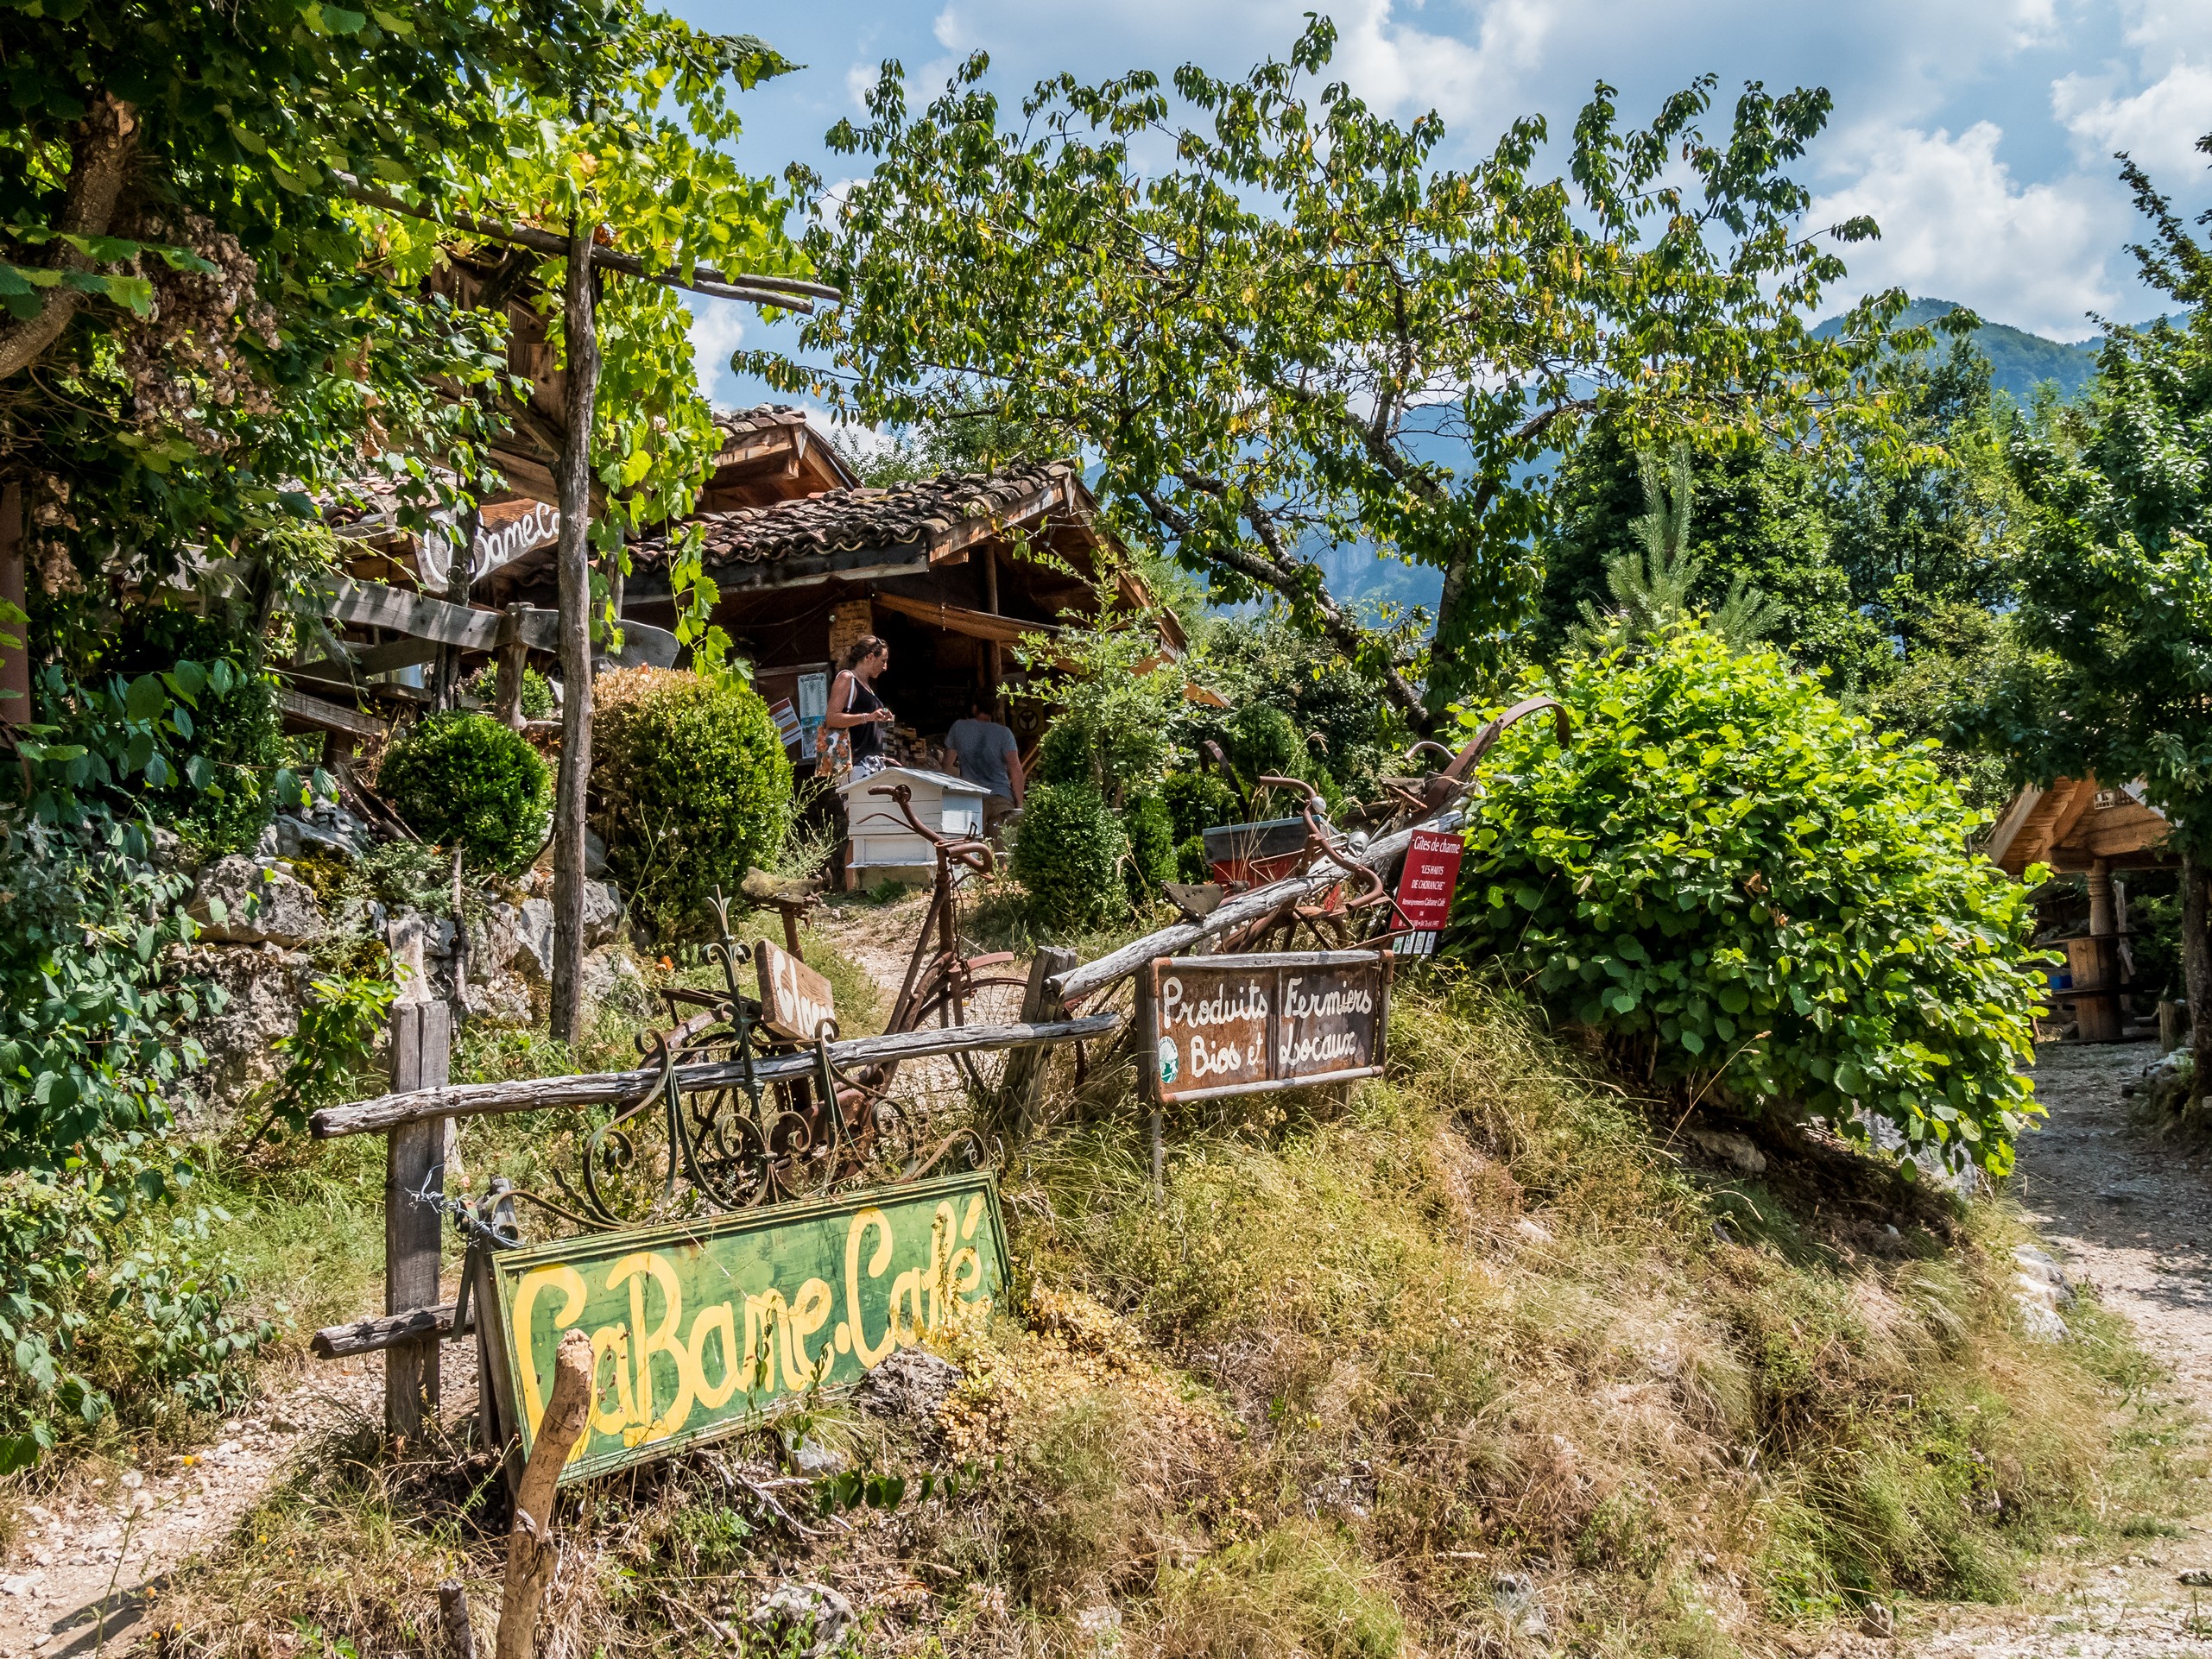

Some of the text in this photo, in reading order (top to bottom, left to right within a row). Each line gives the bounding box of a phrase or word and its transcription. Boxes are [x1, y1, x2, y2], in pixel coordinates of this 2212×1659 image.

[1431, 837, 1439, 851] de
[1440, 838, 1461, 854] charme
[1163, 976, 1373, 1029] Produits Fermiers
[1279, 1023, 1357, 1067] Locaux
